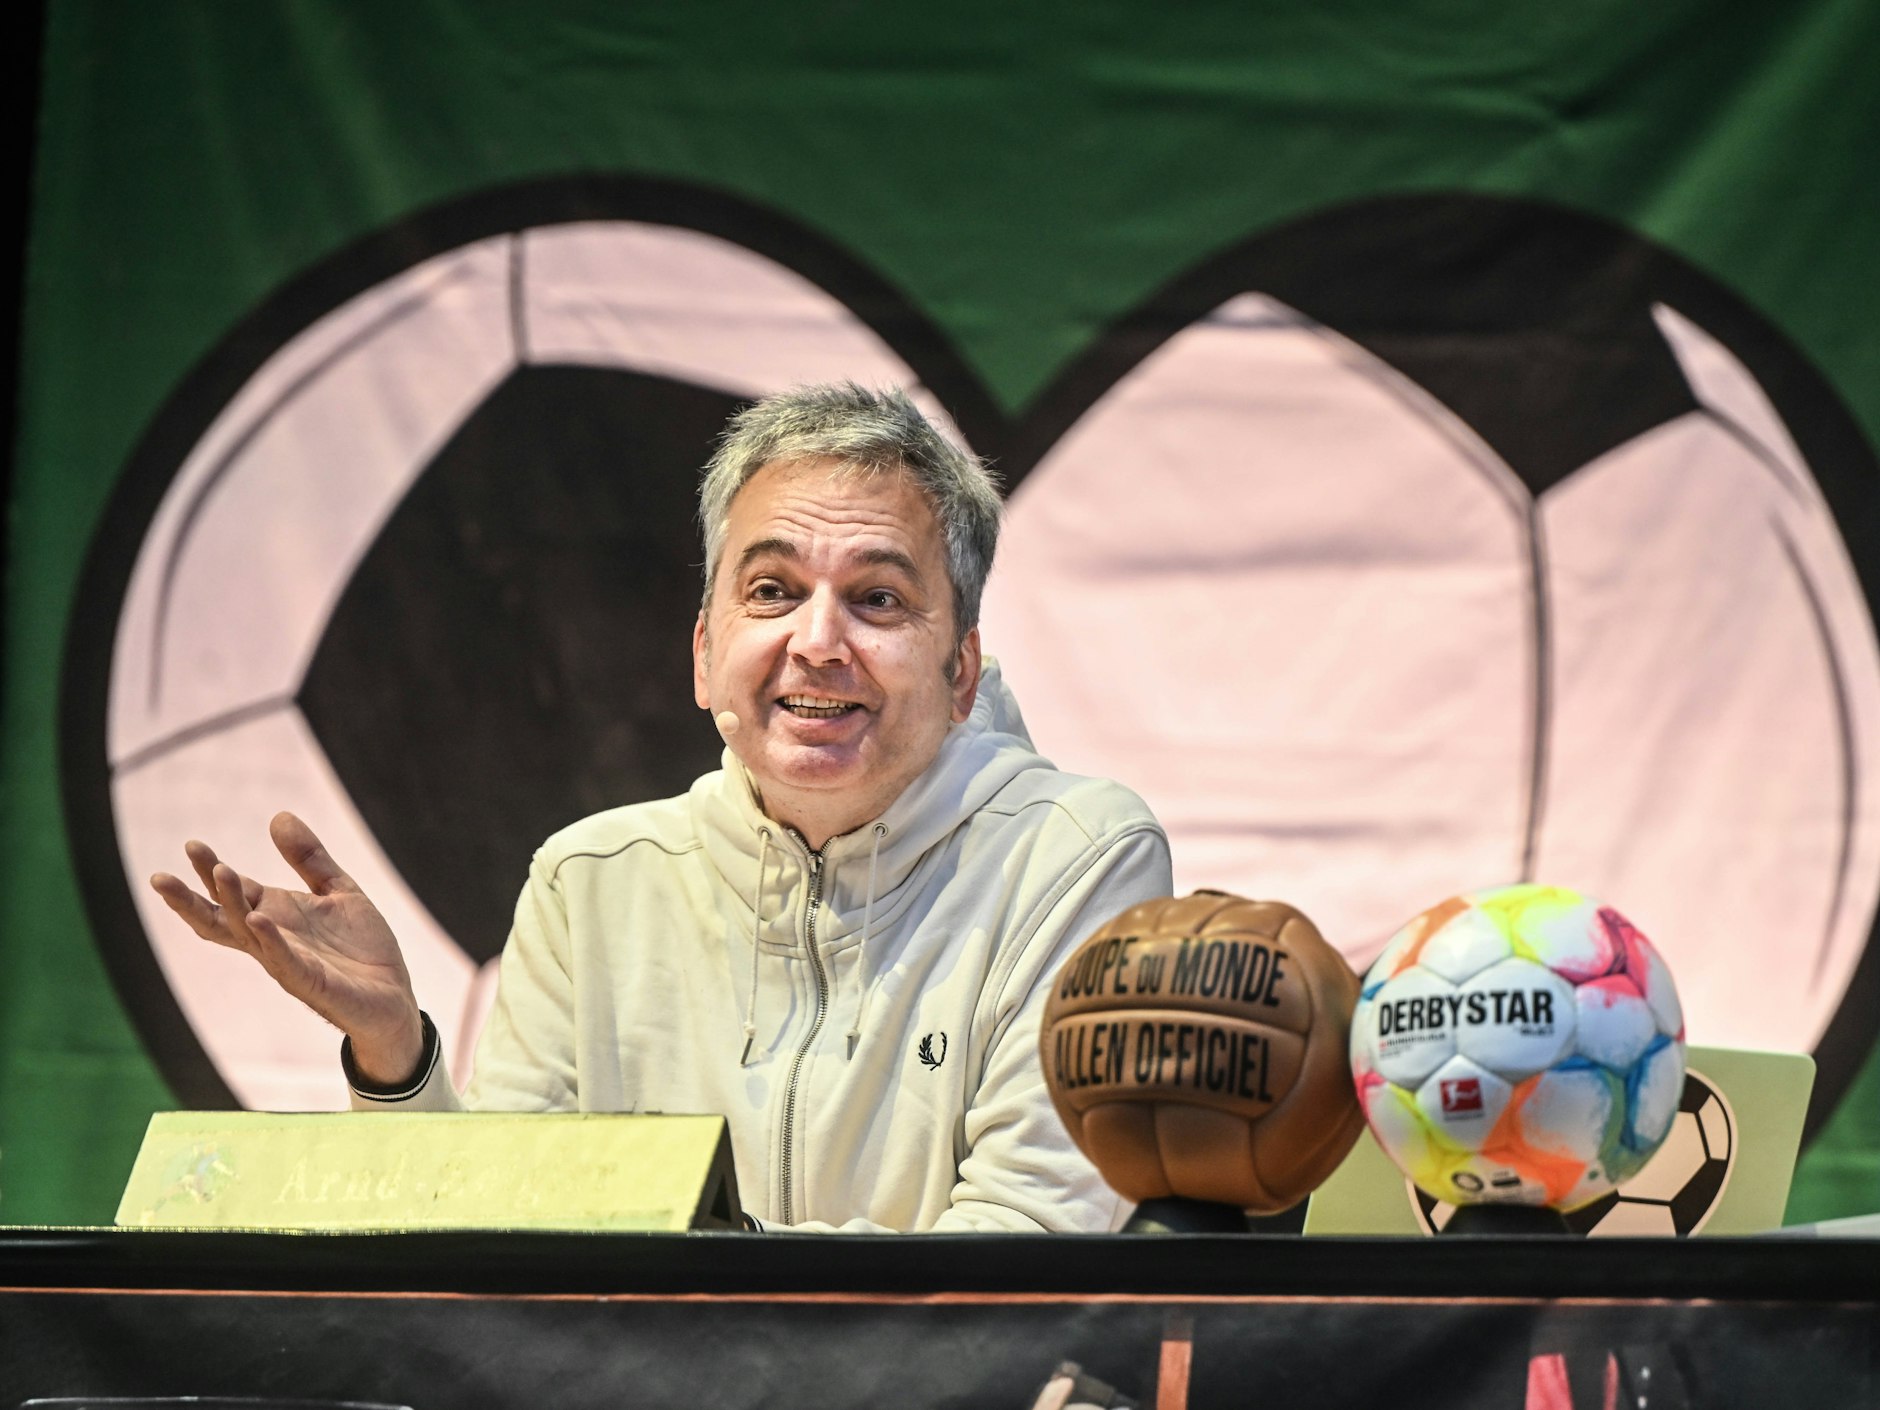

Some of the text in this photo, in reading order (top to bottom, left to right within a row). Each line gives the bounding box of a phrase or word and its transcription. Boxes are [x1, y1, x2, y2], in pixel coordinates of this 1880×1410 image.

[1170, 938, 1288, 1007] MONDE
[1378, 989, 1554, 1036] DERBYSTAR
[1135, 1022, 1273, 1103] OFFICIEL
